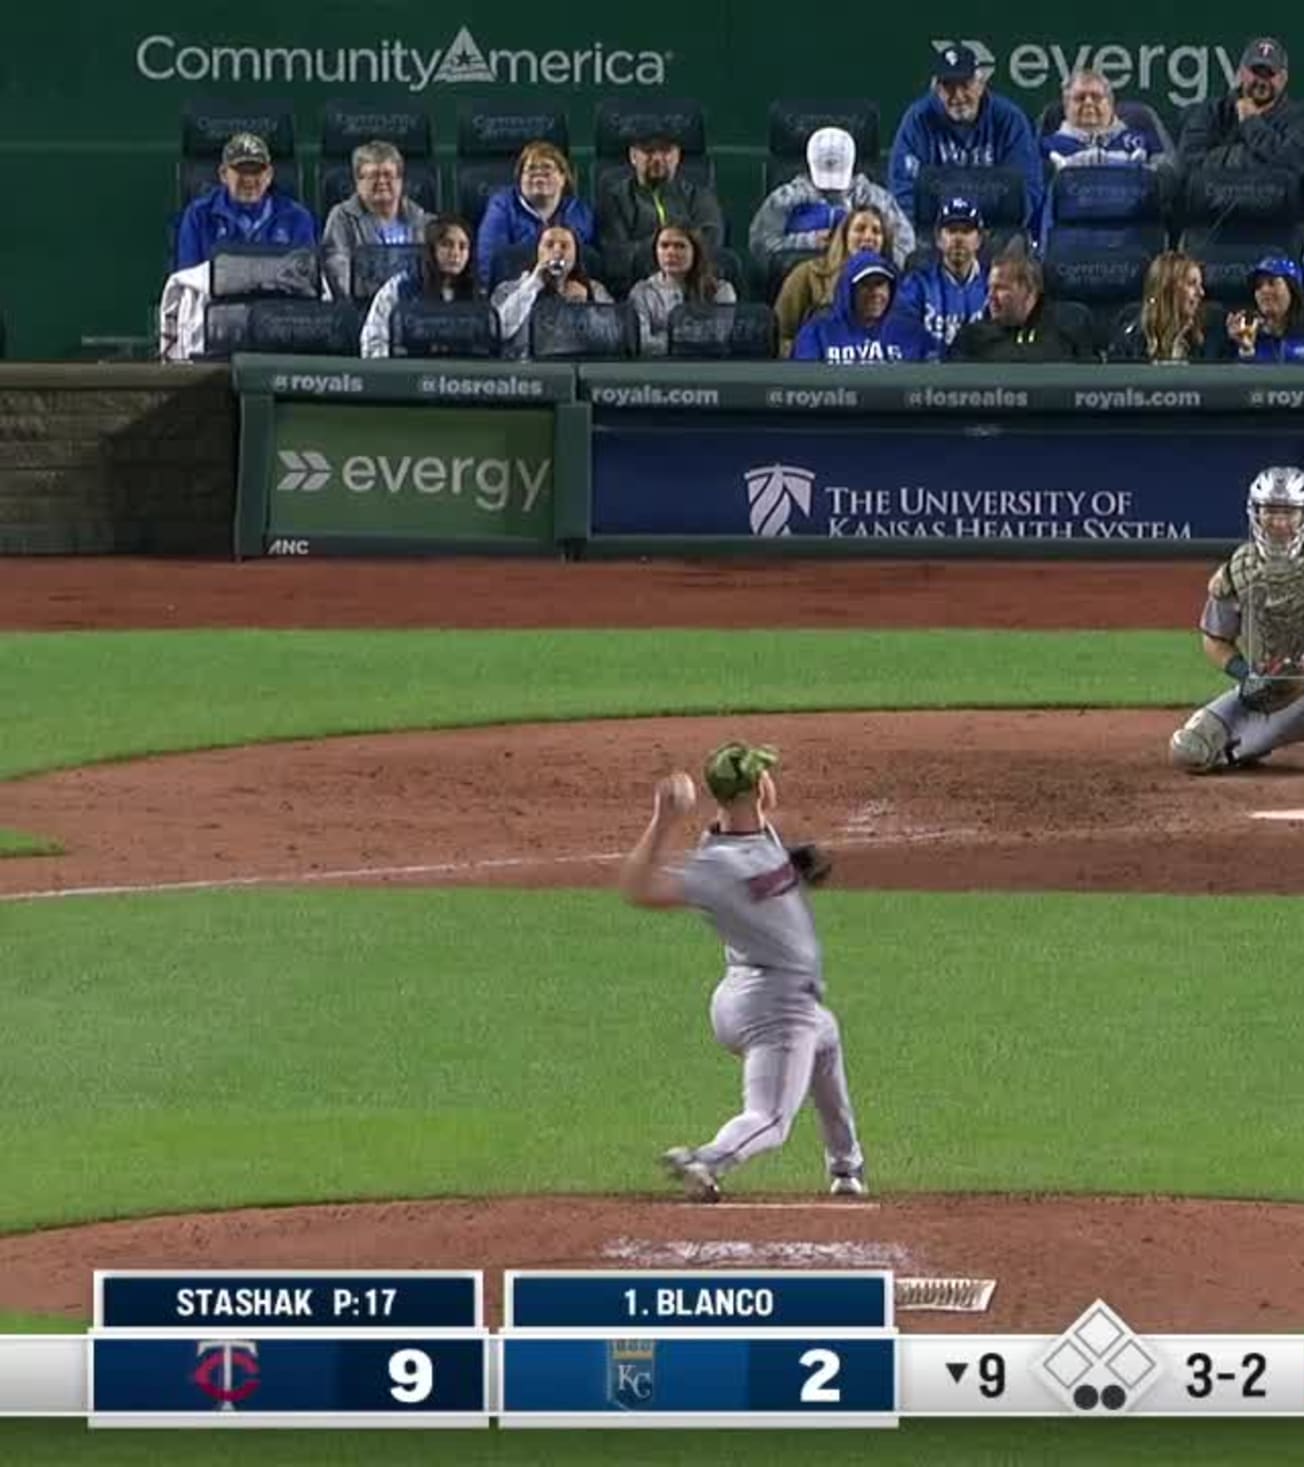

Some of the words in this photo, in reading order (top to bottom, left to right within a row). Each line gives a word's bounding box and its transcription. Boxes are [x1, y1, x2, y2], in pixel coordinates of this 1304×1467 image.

[273, 374, 364, 394] @royals
[421, 376, 543, 396] @losreales
[592, 385, 720, 406] royals.com
[769, 388, 858, 408] @royals
[910, 388, 1029, 407] @losreales
[1074, 388, 1202, 409] royals.com
[341, 453, 552, 511] evergy
[825, 487, 891, 515] THE
[901, 487, 1086, 515] UNIVERSITY
[1091, 490, 1132, 515] OF
[828, 518, 946, 538] KANSAS
[955, 518, 1072, 538] HEALTH
[1082, 519, 1192, 539] SYSTEM
[267, 538, 310, 555] ANC
